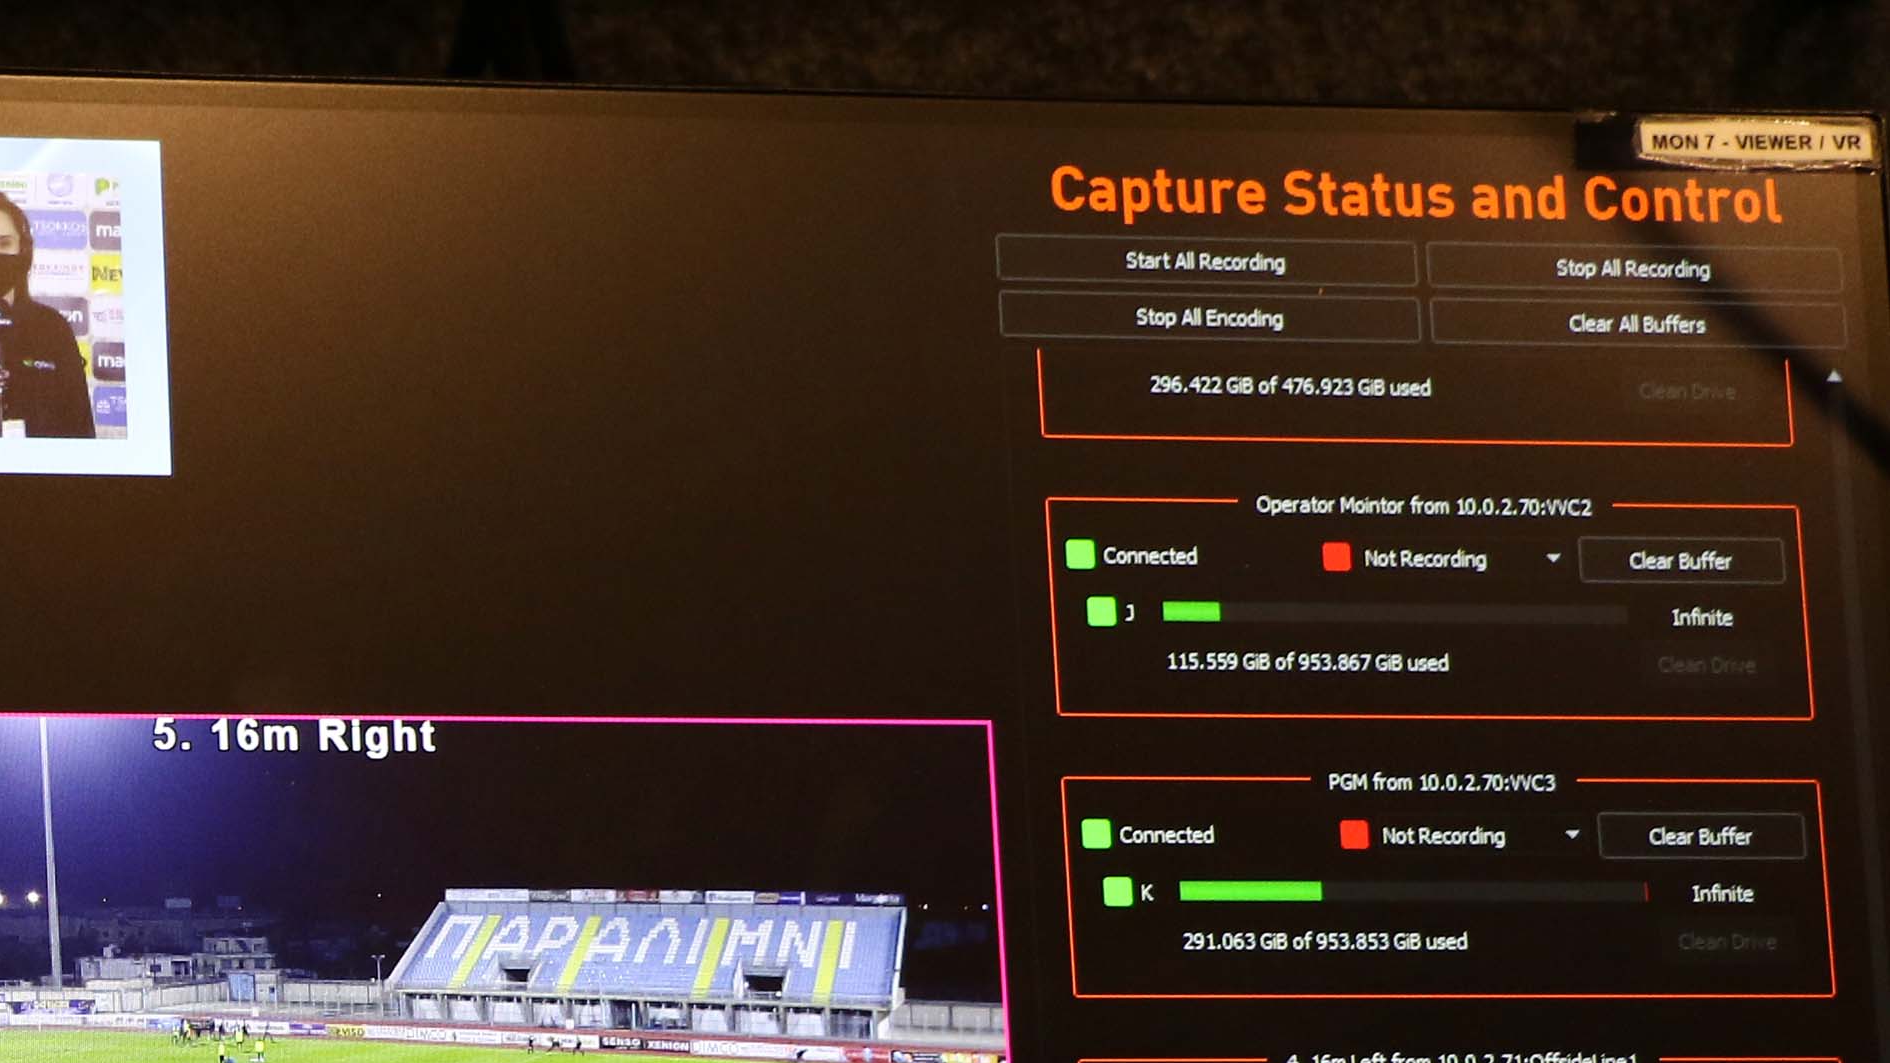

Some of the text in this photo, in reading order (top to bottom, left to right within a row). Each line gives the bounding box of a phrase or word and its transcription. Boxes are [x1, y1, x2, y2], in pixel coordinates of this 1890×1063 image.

[1652, 134, 1699, 150] MON
[1705, 135, 1715, 150] 7
[1735, 134, 1811, 150] VIEWER
[1831, 134, 1861, 150] VR
[1051, 165, 1784, 225] Capture Status and Control
[1125, 251, 1286, 276] Start All Recording
[1556, 258, 1711, 282] Stop All Recording
[1136, 307, 1284, 332] Stop All Encoding
[1569, 313, 1706, 334] Clear All Buffers
[1150, 375, 1432, 397] 296.422 GiB of 476.923 GiB used
[1256, 495, 1593, 517] Operator Mointor from 10.0.2.70:VVC2
[1103, 545, 1198, 566] Connected
[1364, 548, 1488, 572] Not Recording
[1629, 550, 1733, 571] Clear Buffer
[1671, 606, 1734, 627] Infinite
[1167, 651, 1450, 672] 115.559 GiB of 953.867 GiB used
[152, 718, 437, 759] 5. 16m Right
[1328, 771, 1556, 792] PGM from 10.0.2.70:VVC3
[1140, 883, 1155, 902] K
